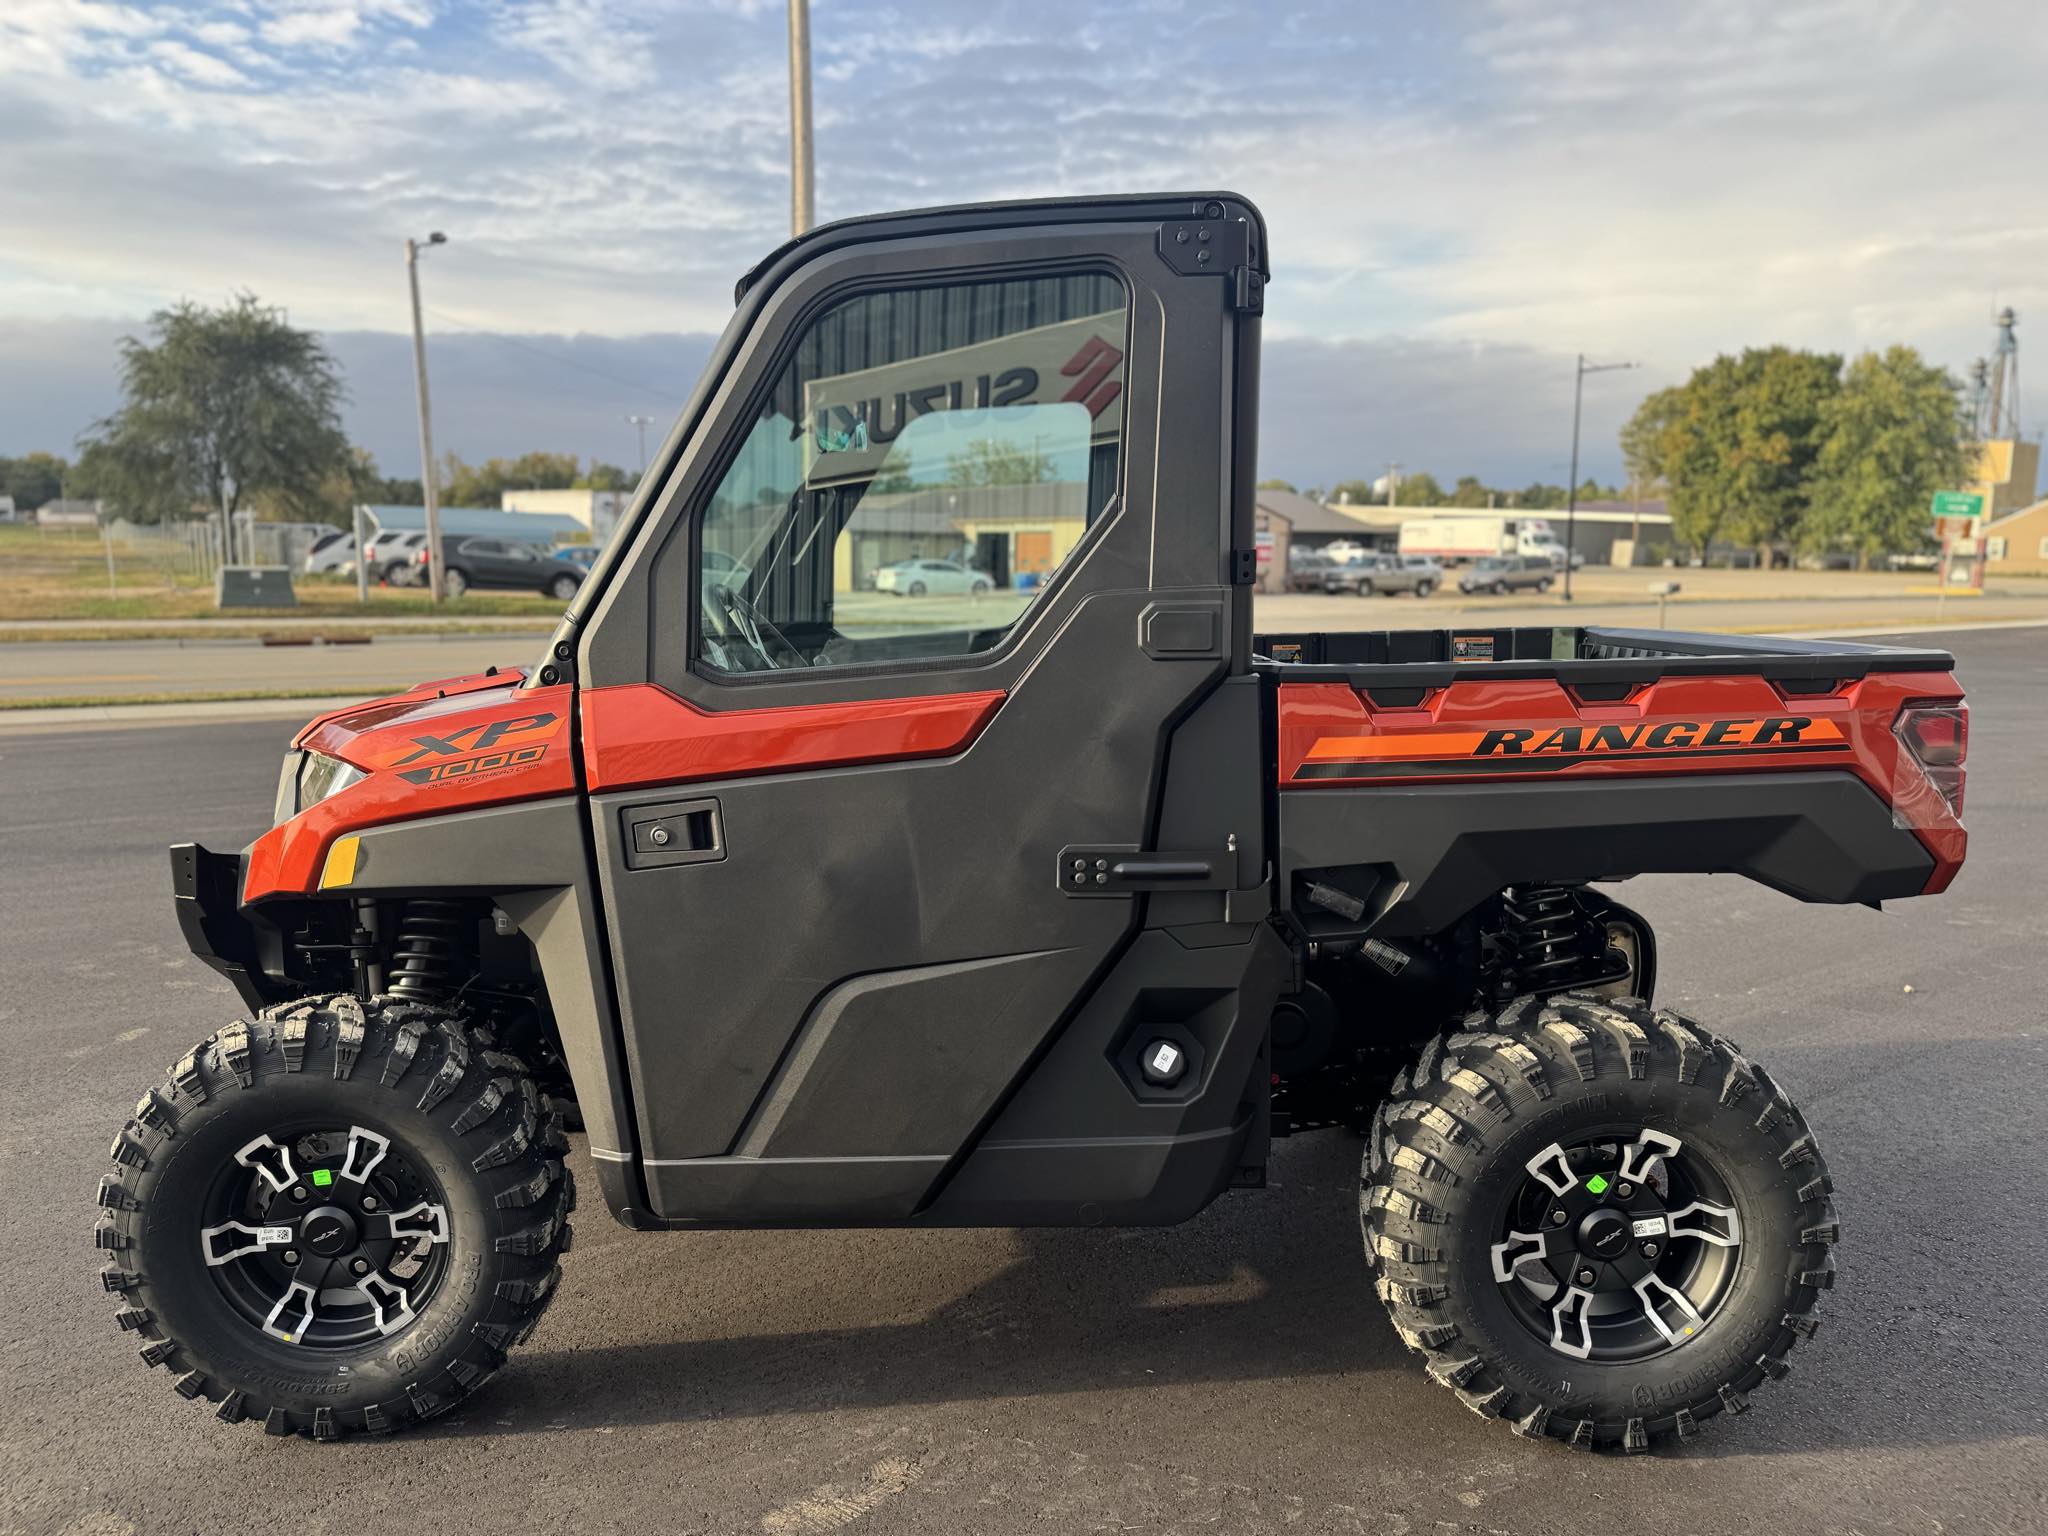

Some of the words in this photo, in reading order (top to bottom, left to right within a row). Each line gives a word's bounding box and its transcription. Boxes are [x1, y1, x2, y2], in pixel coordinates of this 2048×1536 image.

[388, 712, 560, 767] XP
[1470, 716, 1812, 756] RANGER
[429, 747, 545, 781] 1000
